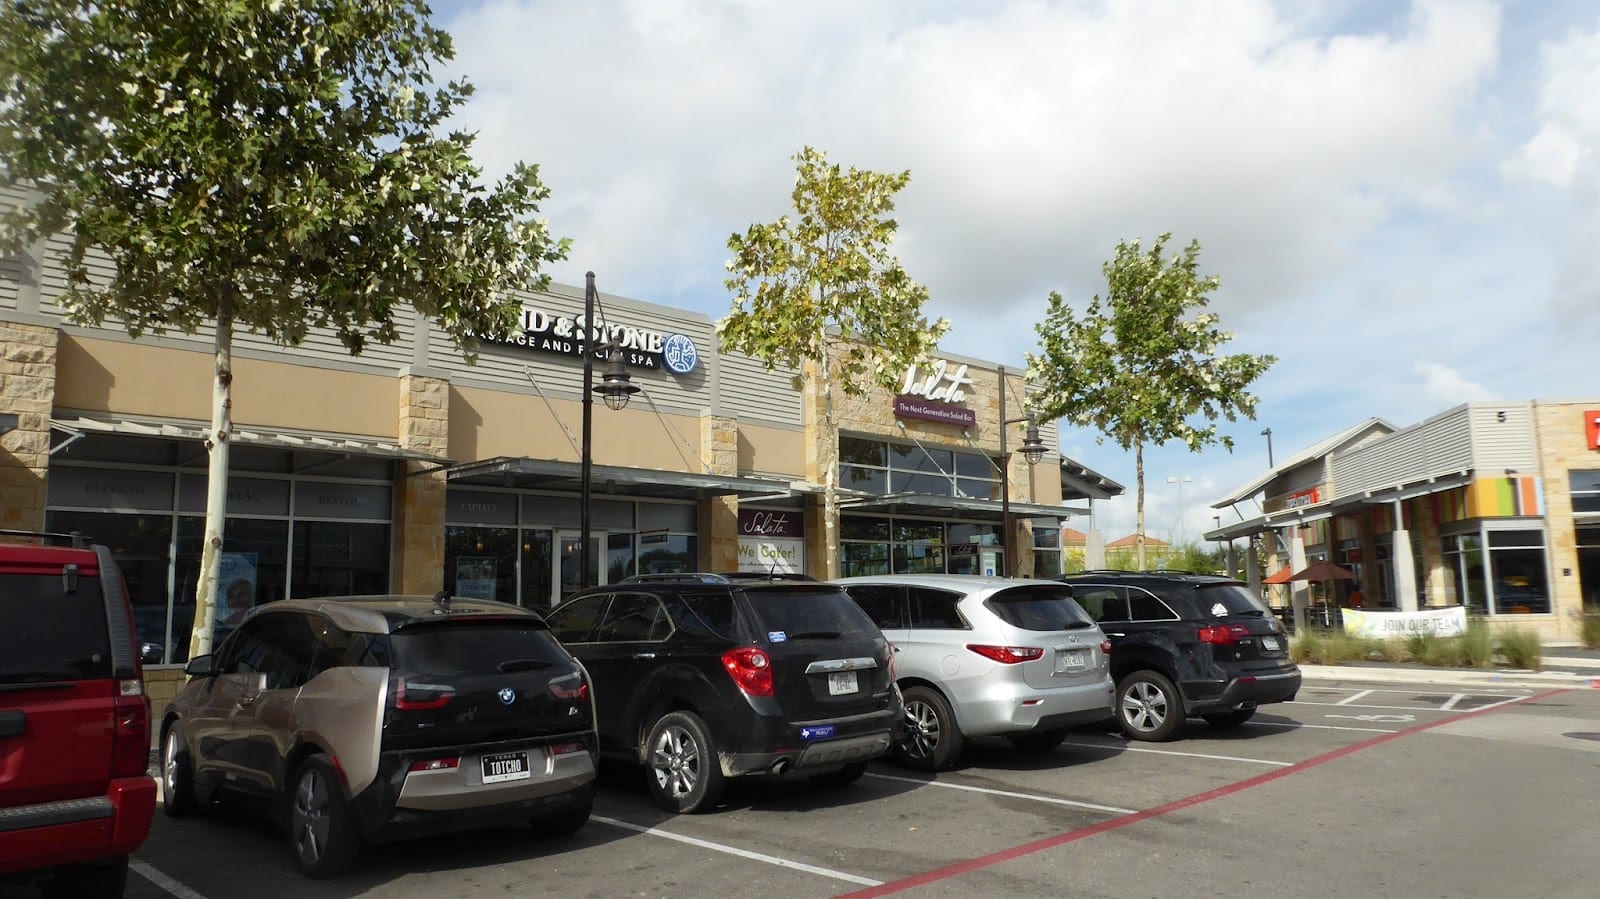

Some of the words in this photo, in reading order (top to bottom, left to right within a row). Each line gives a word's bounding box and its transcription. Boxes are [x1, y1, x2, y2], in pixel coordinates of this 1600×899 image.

[554, 317, 573, 338] &
[576, 315, 664, 354] STONE
[542, 339, 571, 353] AND
[631, 354, 654, 367] SPA
[900, 402, 909, 411] The
[910, 405, 922, 414] Next
[923, 407, 950, 418] Generation
[950, 411, 963, 420] Salad
[744, 511, 789, 534] Salata
[737, 544, 755, 558] We
[761, 544, 796, 560] Cater!
[1381, 619, 1405, 632] JOIN
[1408, 618, 1430, 631] OUR
[1431, 617, 1462, 634] TEAM
